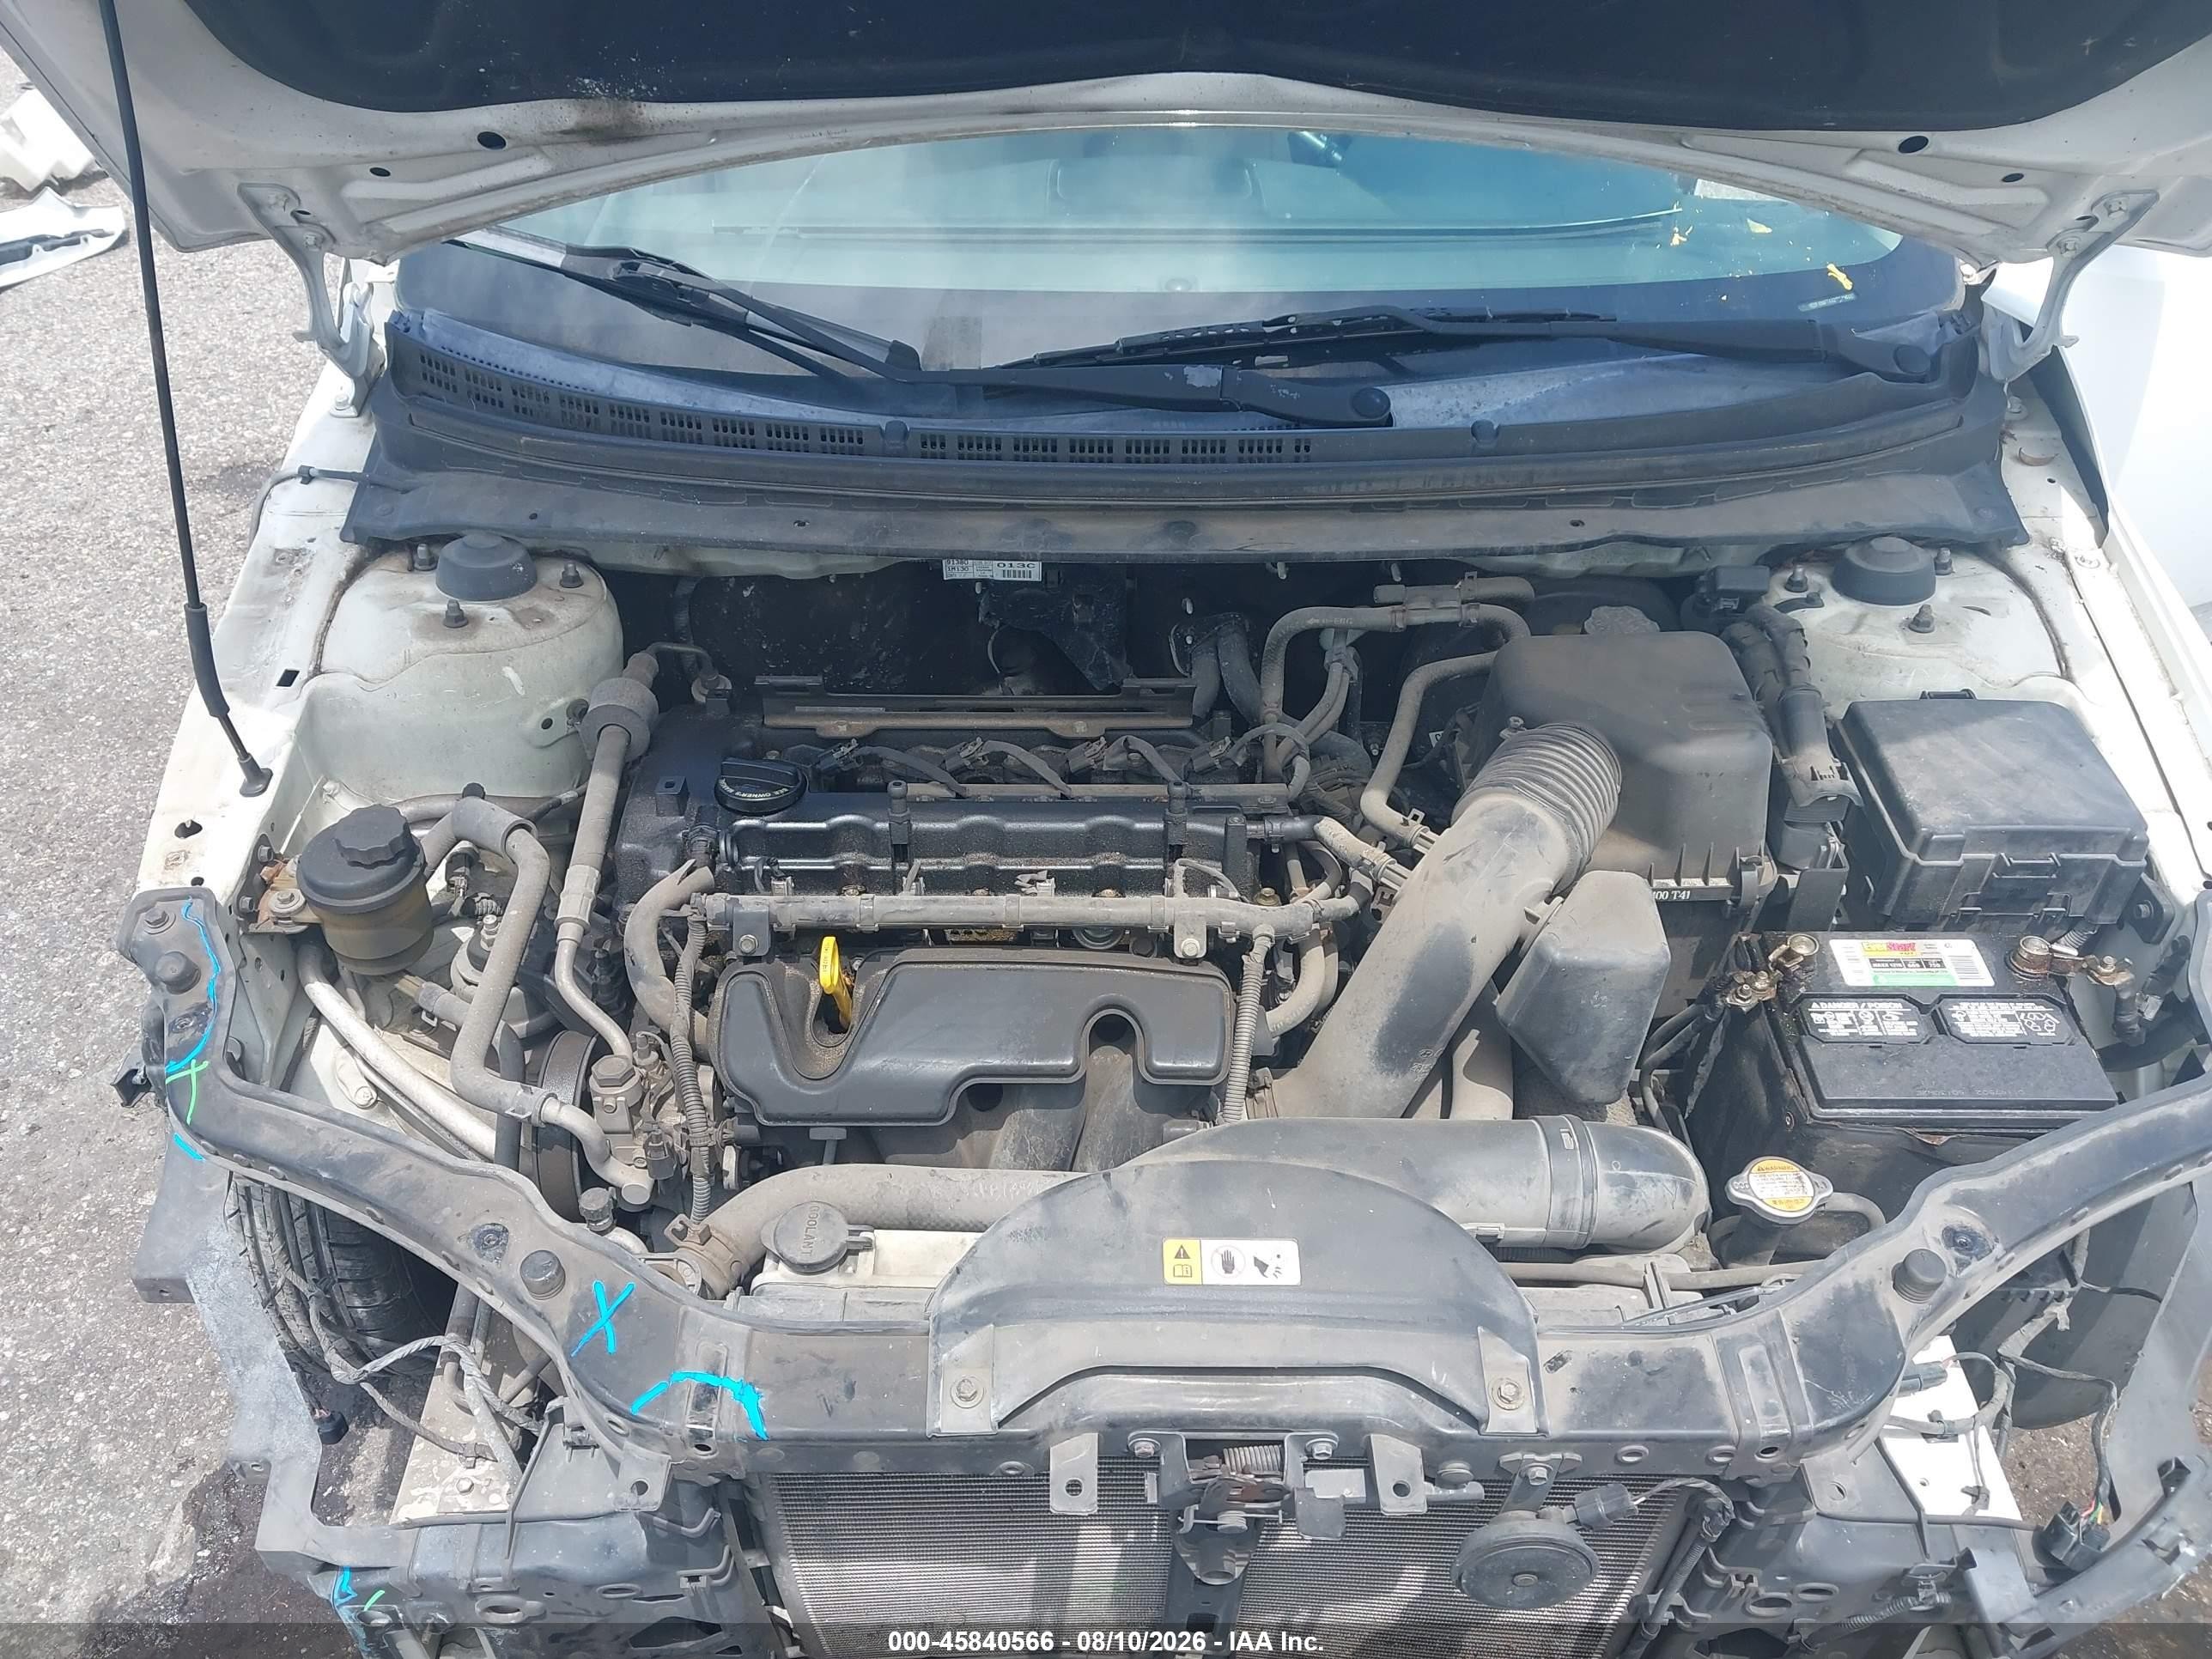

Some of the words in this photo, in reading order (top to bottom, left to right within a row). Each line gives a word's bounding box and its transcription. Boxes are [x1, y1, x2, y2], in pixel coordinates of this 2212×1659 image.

[1653, 890, 1669, 900] 00
[1671, 890, 1691, 900] T41
[801, 1206, 820, 1256] COOLANT
